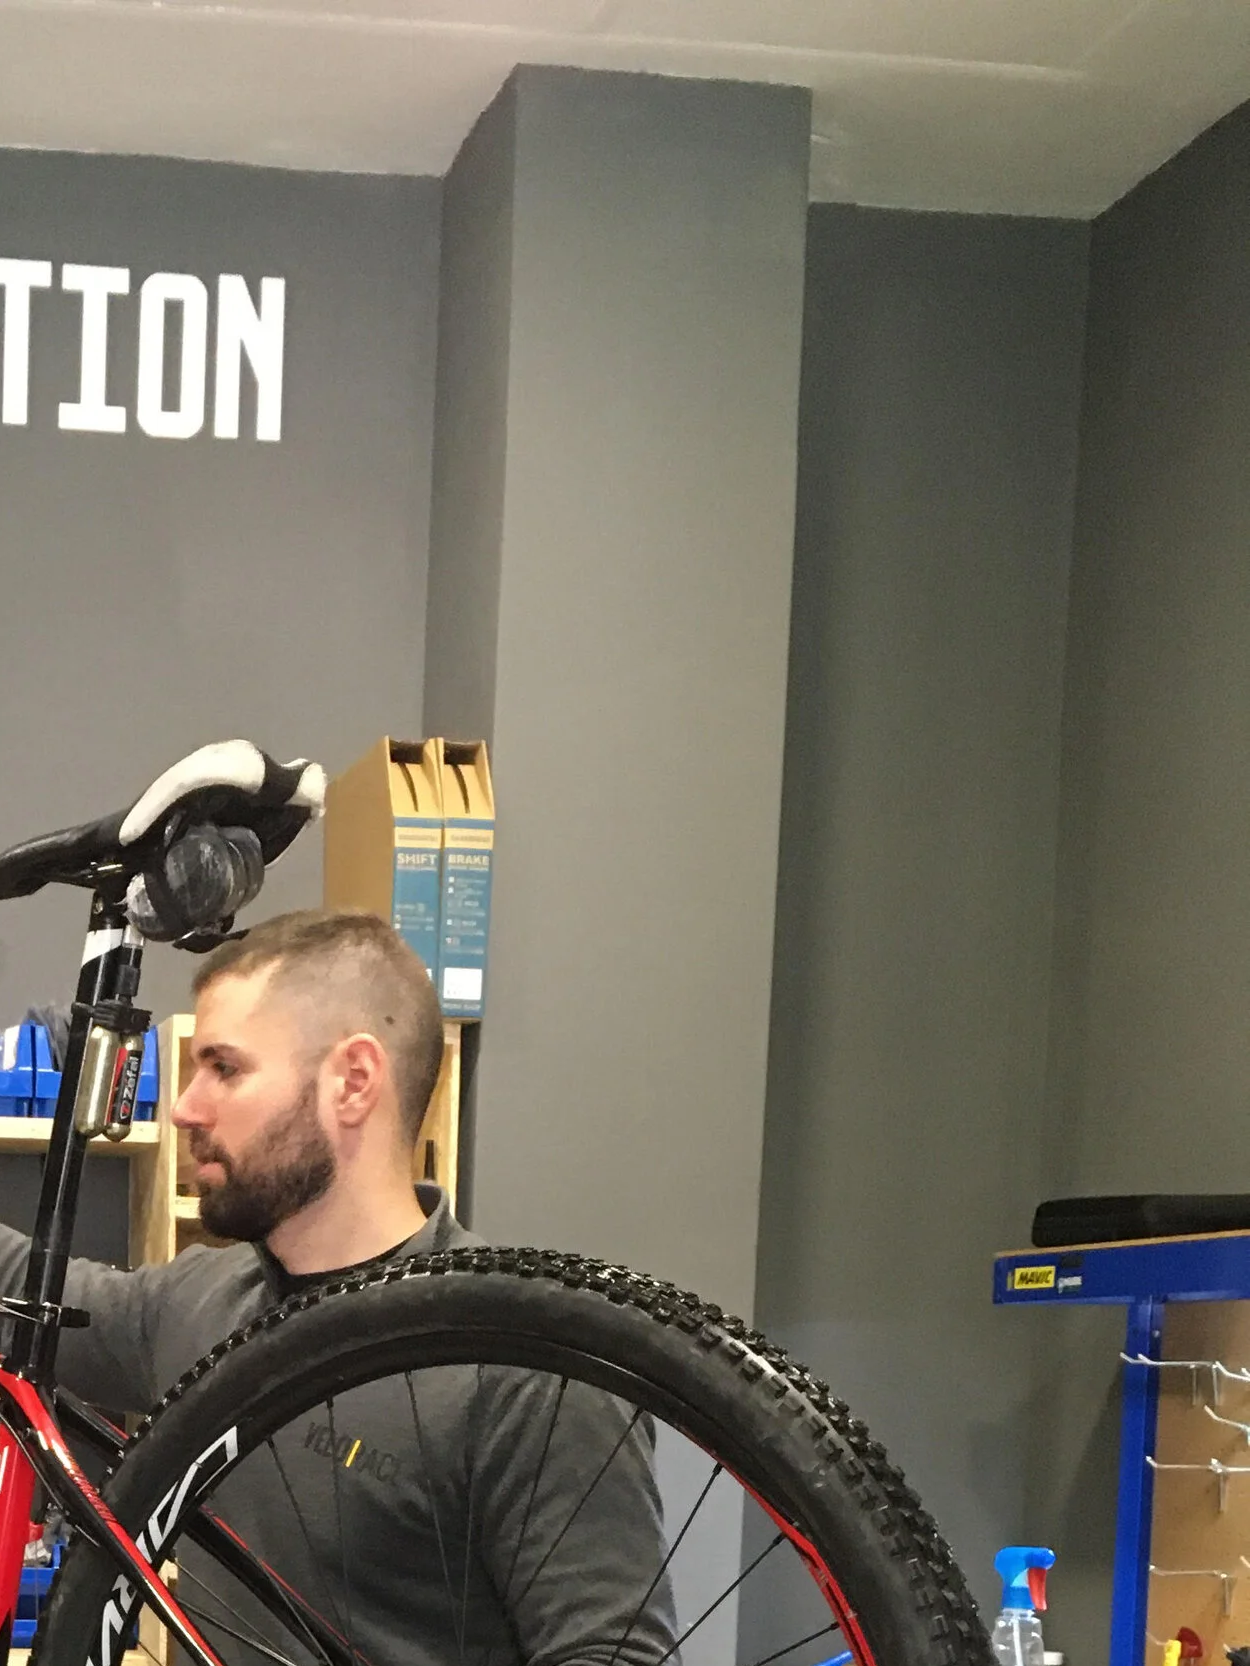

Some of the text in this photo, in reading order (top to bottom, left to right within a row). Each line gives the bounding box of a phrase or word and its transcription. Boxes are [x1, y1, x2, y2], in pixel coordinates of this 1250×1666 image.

[397, 853, 437, 865] SHIFT
[447, 854, 490, 866] BRAKE
[1017, 1269, 1053, 1285] MAVIC
